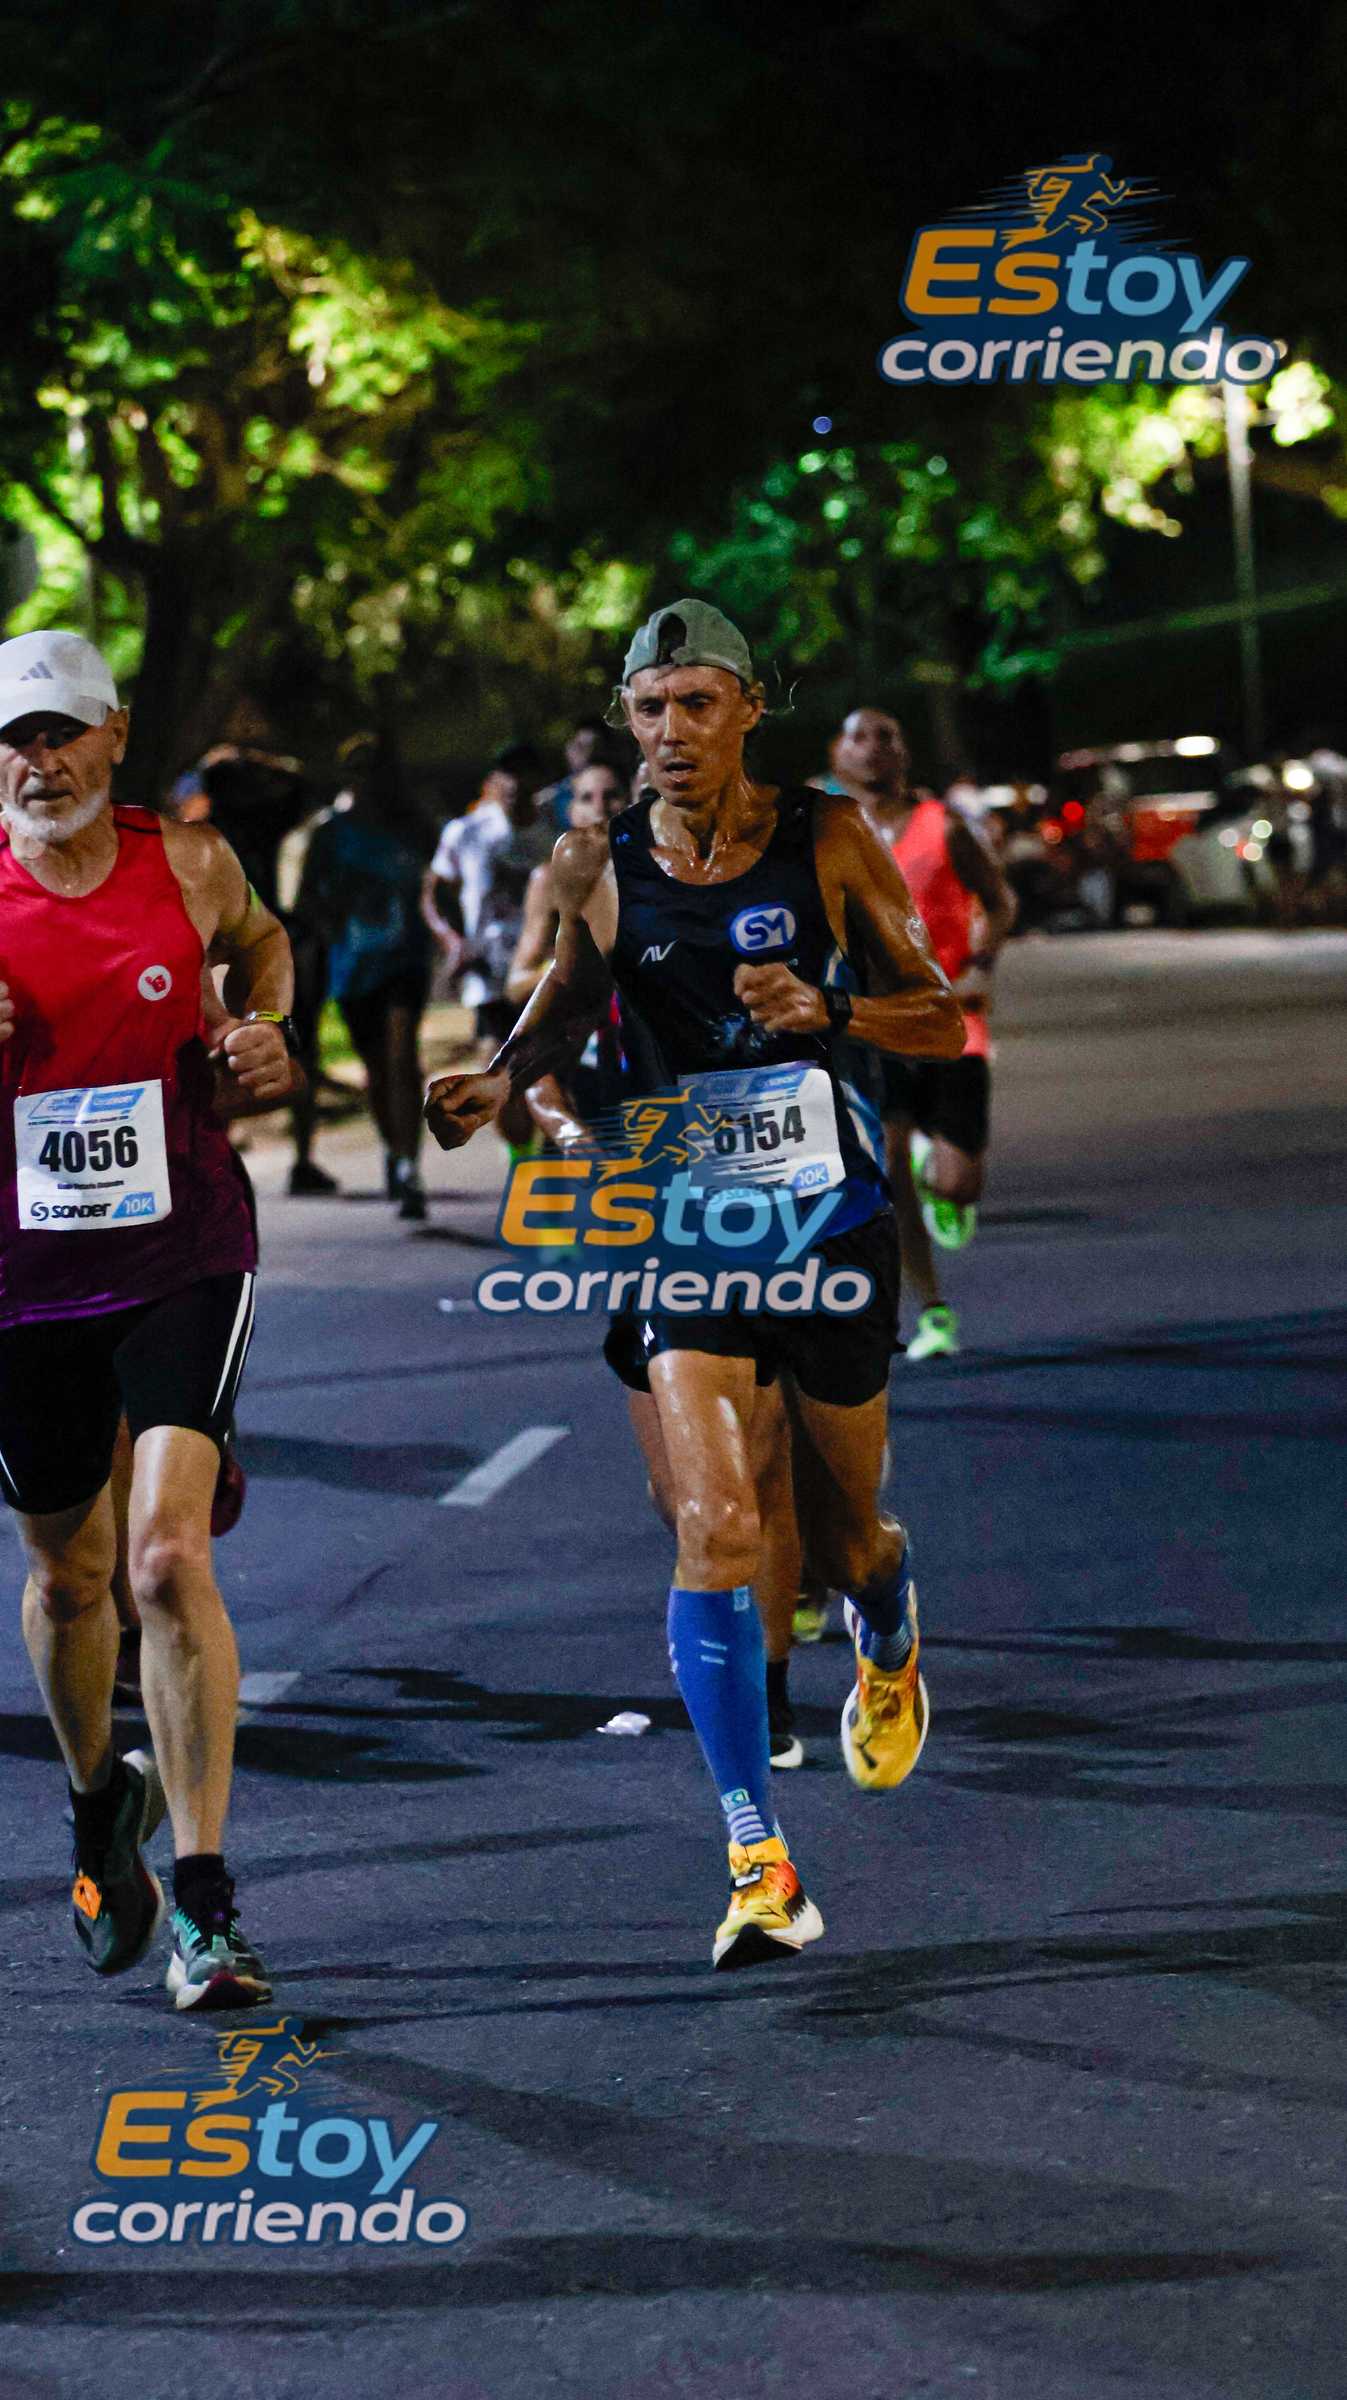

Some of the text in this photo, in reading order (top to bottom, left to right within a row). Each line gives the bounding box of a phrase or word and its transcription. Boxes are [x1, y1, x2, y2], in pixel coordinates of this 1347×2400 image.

[713, 1104, 806, 1156] 6154
[38, 1125, 139, 1173] 4056
[798, 1165, 829, 1187] 10K
[125, 1196, 153, 1213] 10K
